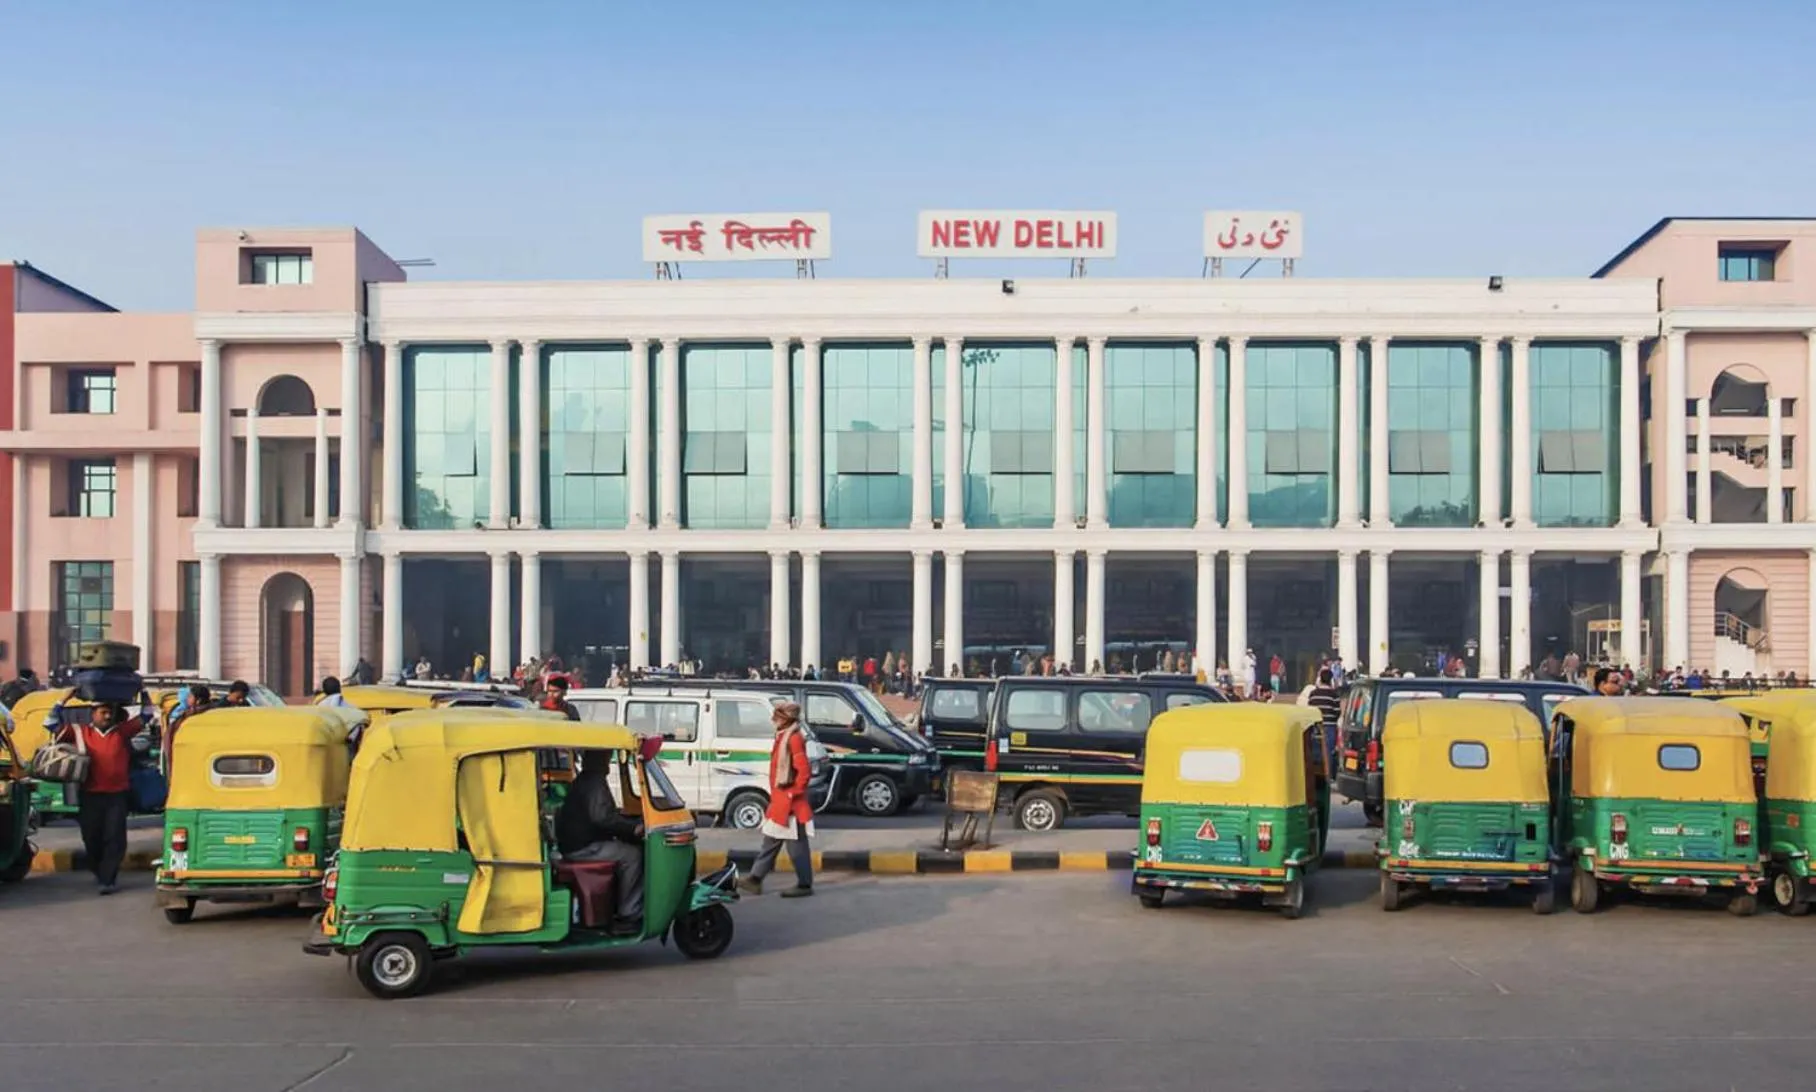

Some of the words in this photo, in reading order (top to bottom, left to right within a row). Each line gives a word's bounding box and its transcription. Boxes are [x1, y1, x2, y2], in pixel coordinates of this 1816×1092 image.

[658, 220, 707, 254] नई
[720, 219, 817, 253] दिल्ली
[931, 219, 1001, 249] NEW
[1013, 219, 1105, 249] DELHI
[1609, 842, 1629, 860] CNG
